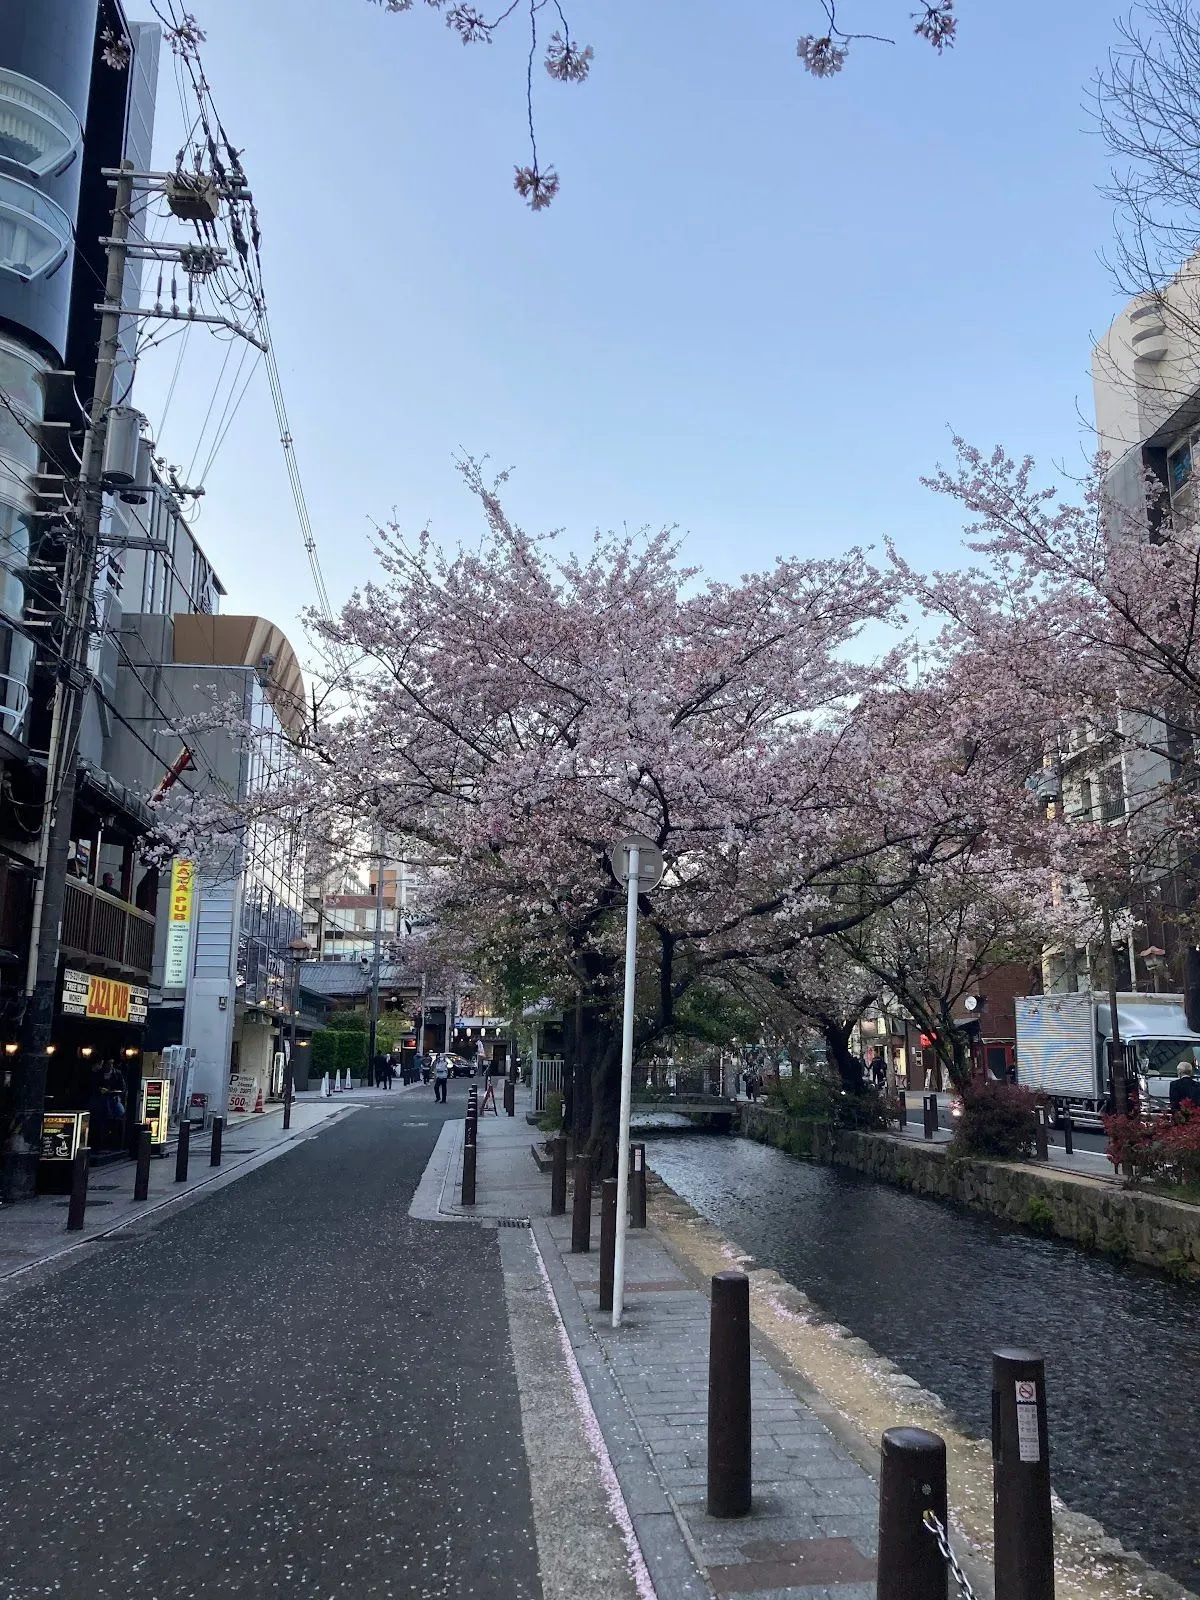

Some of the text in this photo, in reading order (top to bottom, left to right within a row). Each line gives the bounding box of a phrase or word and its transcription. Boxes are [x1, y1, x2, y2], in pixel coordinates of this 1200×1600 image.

[174, 896, 187, 921] PUB
[89, 979, 128, 1018] ZAZA PUB
